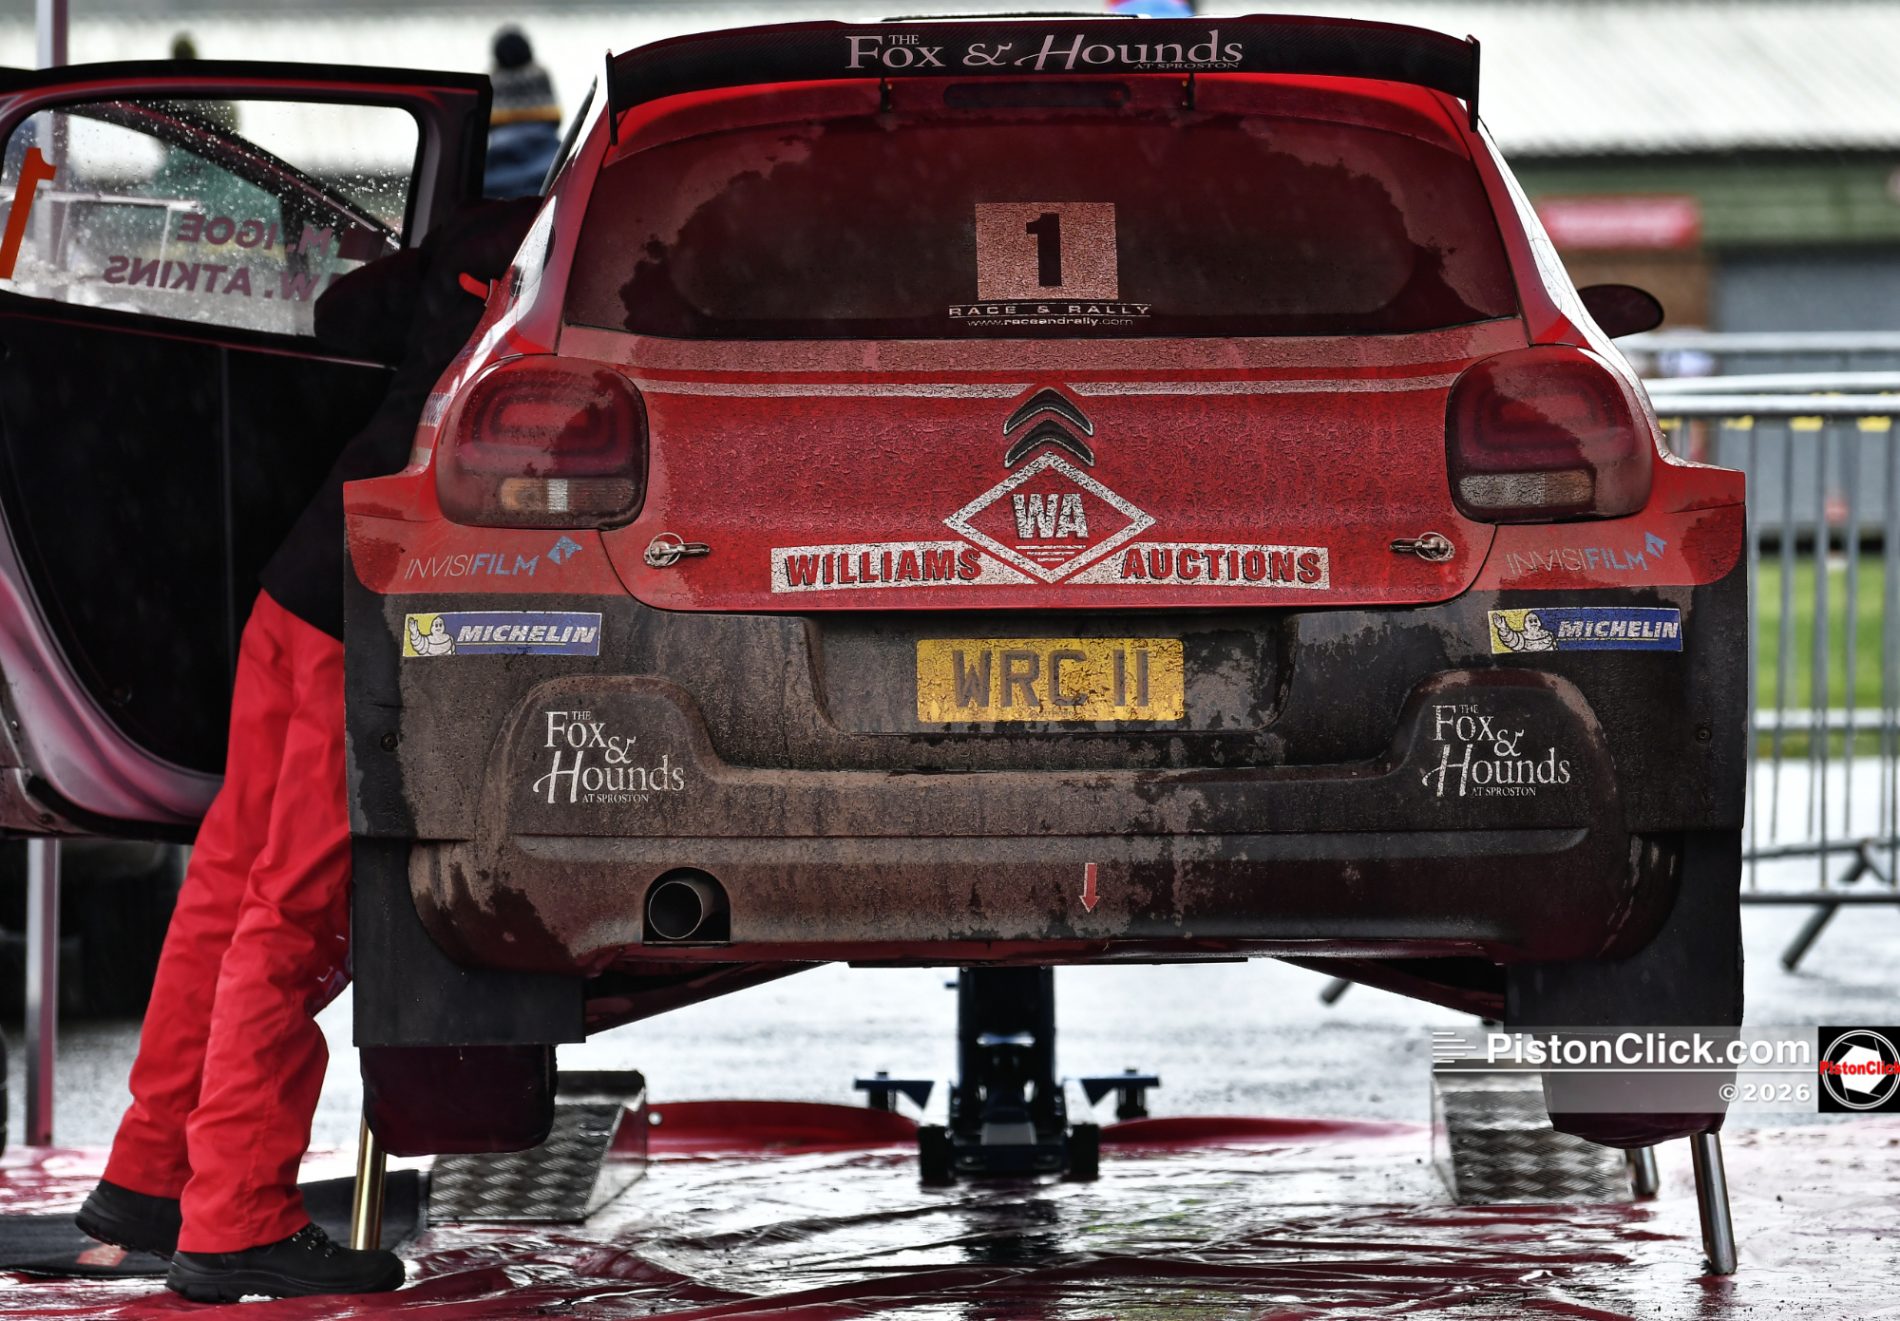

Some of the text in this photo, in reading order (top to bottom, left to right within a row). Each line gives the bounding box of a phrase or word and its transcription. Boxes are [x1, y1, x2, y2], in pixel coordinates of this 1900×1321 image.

[844, 29, 1243, 71] Fox & Hounds
[888, 34, 920, 45] THE
[1133, 62, 1240, 70] AT SPROSTON
[1026, 212, 1062, 287] 1
[949, 305, 1150, 316] RACE & RALLY
[967, 316, 1134, 327] www.raceandrally.com
[1012, 493, 1089, 538] WA
[403, 552, 541, 581] INVISIFILM
[785, 549, 983, 587] WILLIAMS
[1120, 548, 1322, 584] AUCTIONS
[1505, 546, 1649, 577] INVISIFILM
[456, 624, 598, 644] MICHELIN
[1557, 620, 1679, 638] MICHELIN
[952, 648, 1089, 708] WRC
[571, 710, 592, 721] THE
[1432, 704, 1497, 742] Fox
[1459, 703, 1480, 715] THE
[543, 711, 608, 749] Fox
[1493, 728, 1525, 757] &
[603, 735, 637, 765] &
[531, 749, 686, 805] Hounds
[1421, 742, 1572, 798] Hounds
[581, 792, 649, 804] AT SPROSTON
[1471, 785, 1538, 798] AT SPROSTON
